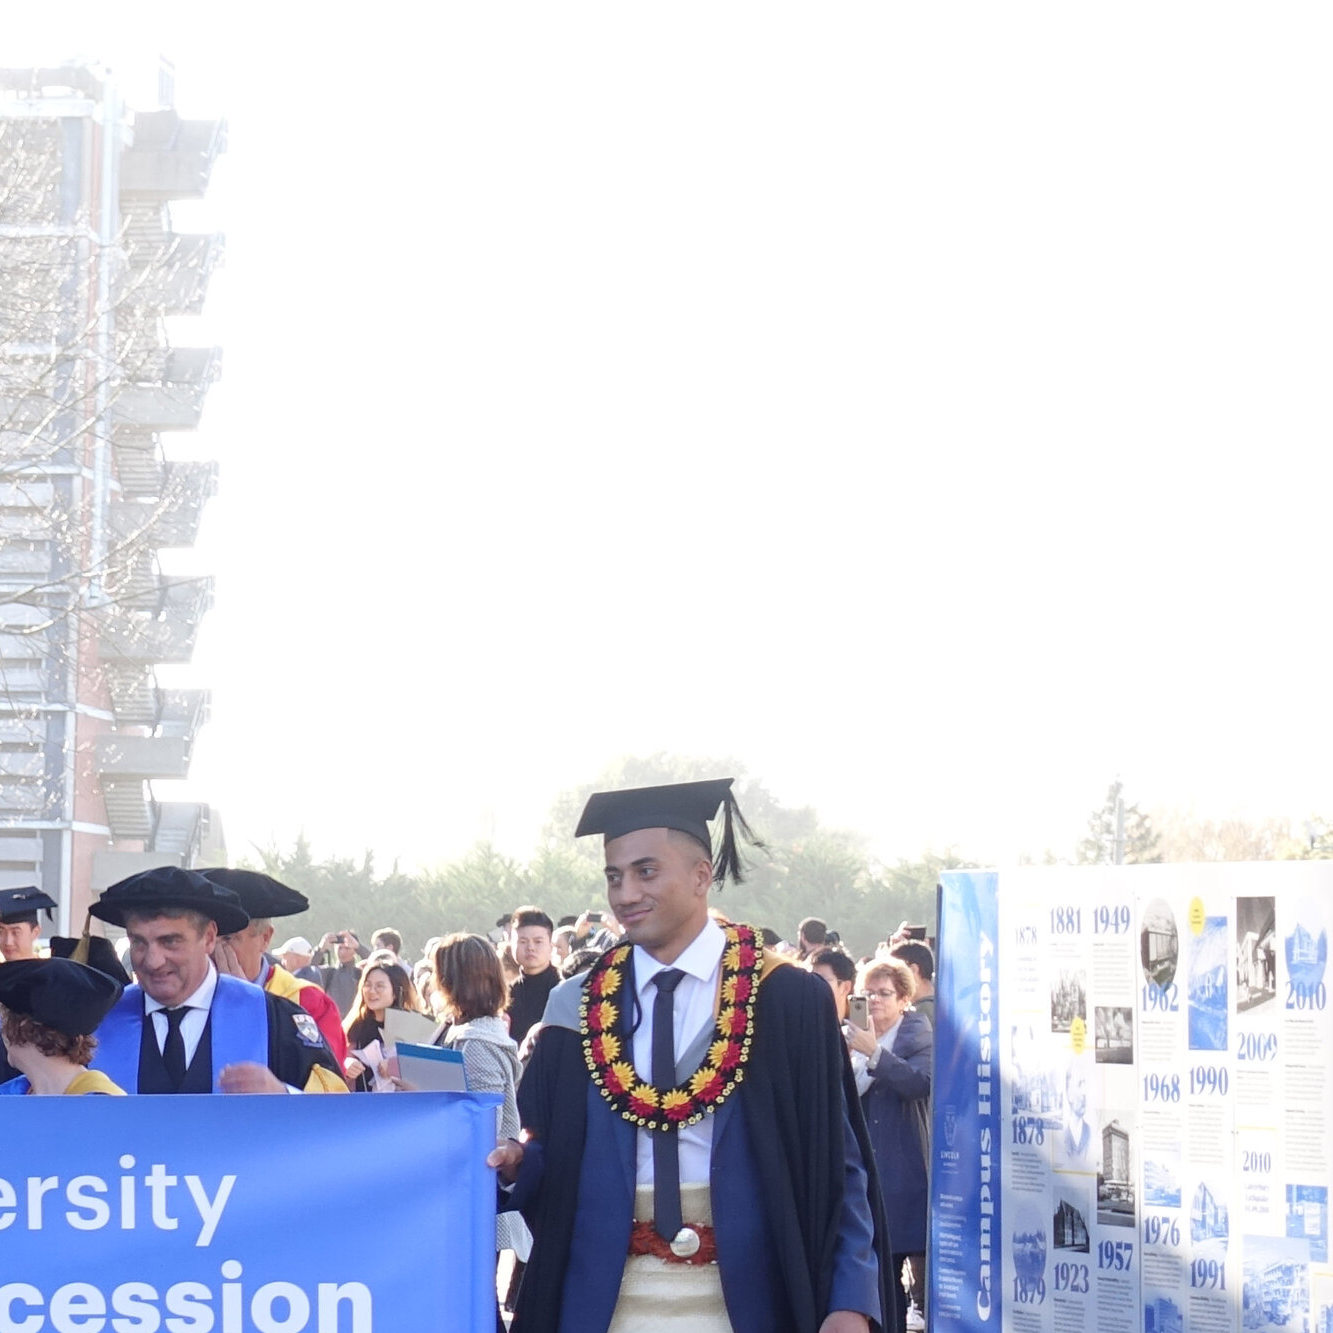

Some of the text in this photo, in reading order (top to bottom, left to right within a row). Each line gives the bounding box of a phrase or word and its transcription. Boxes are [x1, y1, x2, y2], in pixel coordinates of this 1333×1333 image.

[1050, 906, 1082, 935] 1881
[1093, 905, 1131, 935] 1949
[1014, 926, 1038, 946] 1878
[1141, 981, 1180, 1012] 1962
[1285, 980, 1327, 1011] 2010
[1236, 1032, 1278, 1062] 2009
[1143, 1073, 1181, 1104] 1968
[1188, 1065, 1229, 1097] 1990
[977, 929, 994, 1322] Campus History
[1012, 1116, 1045, 1147] 1878
[1242, 1150, 1272, 1174] 2010
[1144, 1216, 1181, 1247] 1976
[1097, 1240, 1134, 1272] 1957
[1054, 1262, 1090, 1294] 1923
[1189, 1258, 1226, 1291] 1991
[1012, 1275, 1047, 1306] 1879
